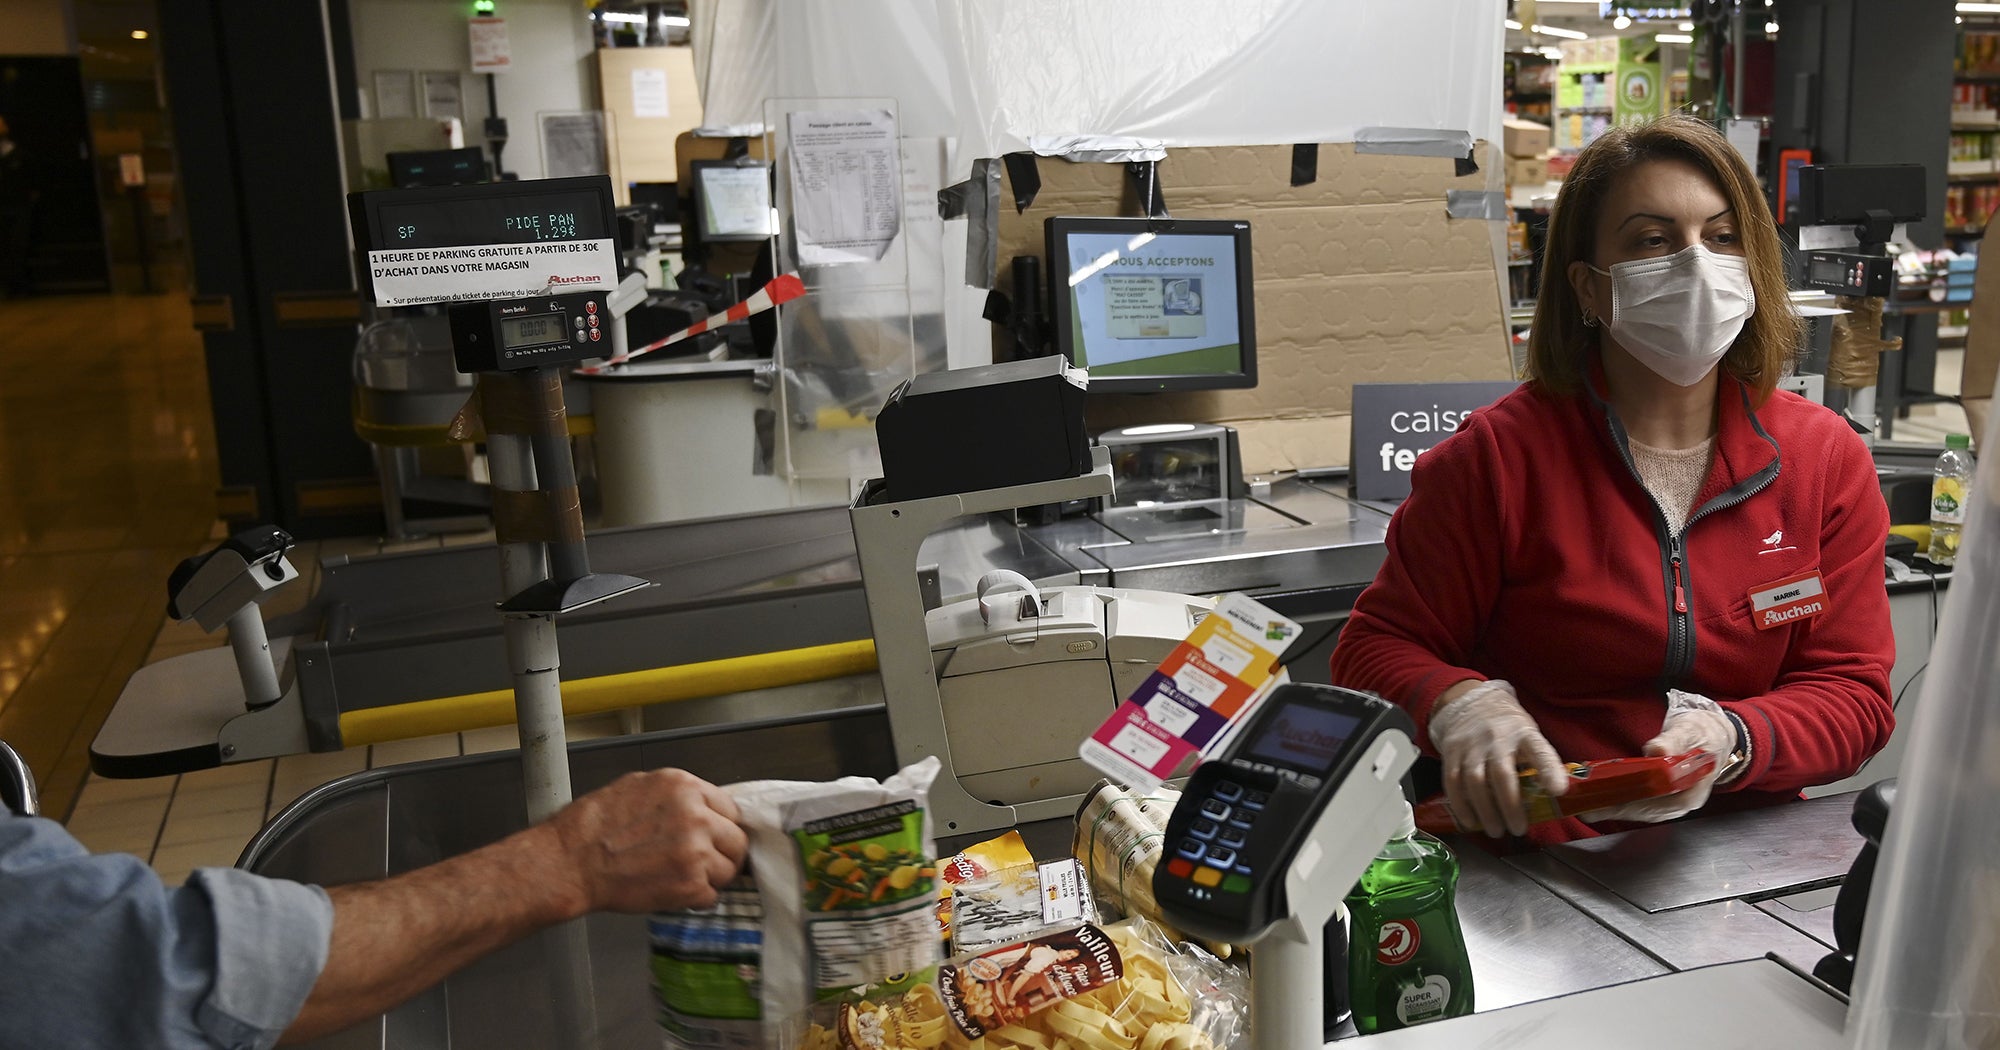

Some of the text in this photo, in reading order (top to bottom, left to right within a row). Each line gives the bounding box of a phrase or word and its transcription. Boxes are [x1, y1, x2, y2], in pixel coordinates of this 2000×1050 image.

[506, 214, 574, 230] PIDE PAN
[398, 226, 416, 238] SP
[536, 225, 576, 239] 1.29€
[372, 243, 599, 264] 1 HEURE DE PARKING GRATUITE A PARTIR DE 30€
[1148, 257, 1214, 266] ACCEPTONS
[374, 260, 529, 278] D'ACHAT DANS VOTRE MAGASIN
[548, 275, 601, 285] Auchan
[407, 294, 450, 304] présentation
[462, 291, 480, 300] ticket
[492, 289, 516, 299] parking
[1380, 442, 1430, 472] fe
[1774, 588, 1800, 602] MARINE
[1763, 602, 1822, 625] Auchan
[1074, 926, 1120, 984] Valfleuri
[1052, 964, 1078, 996] d'Alsace
[1072, 963, 1090, 987] Pâtes
[943, 968, 956, 980] 7
[953, 1008, 969, 1031] Plein
[966, 1024, 982, 1038] Air
[1404, 992, 1431, 1004] SUPER
